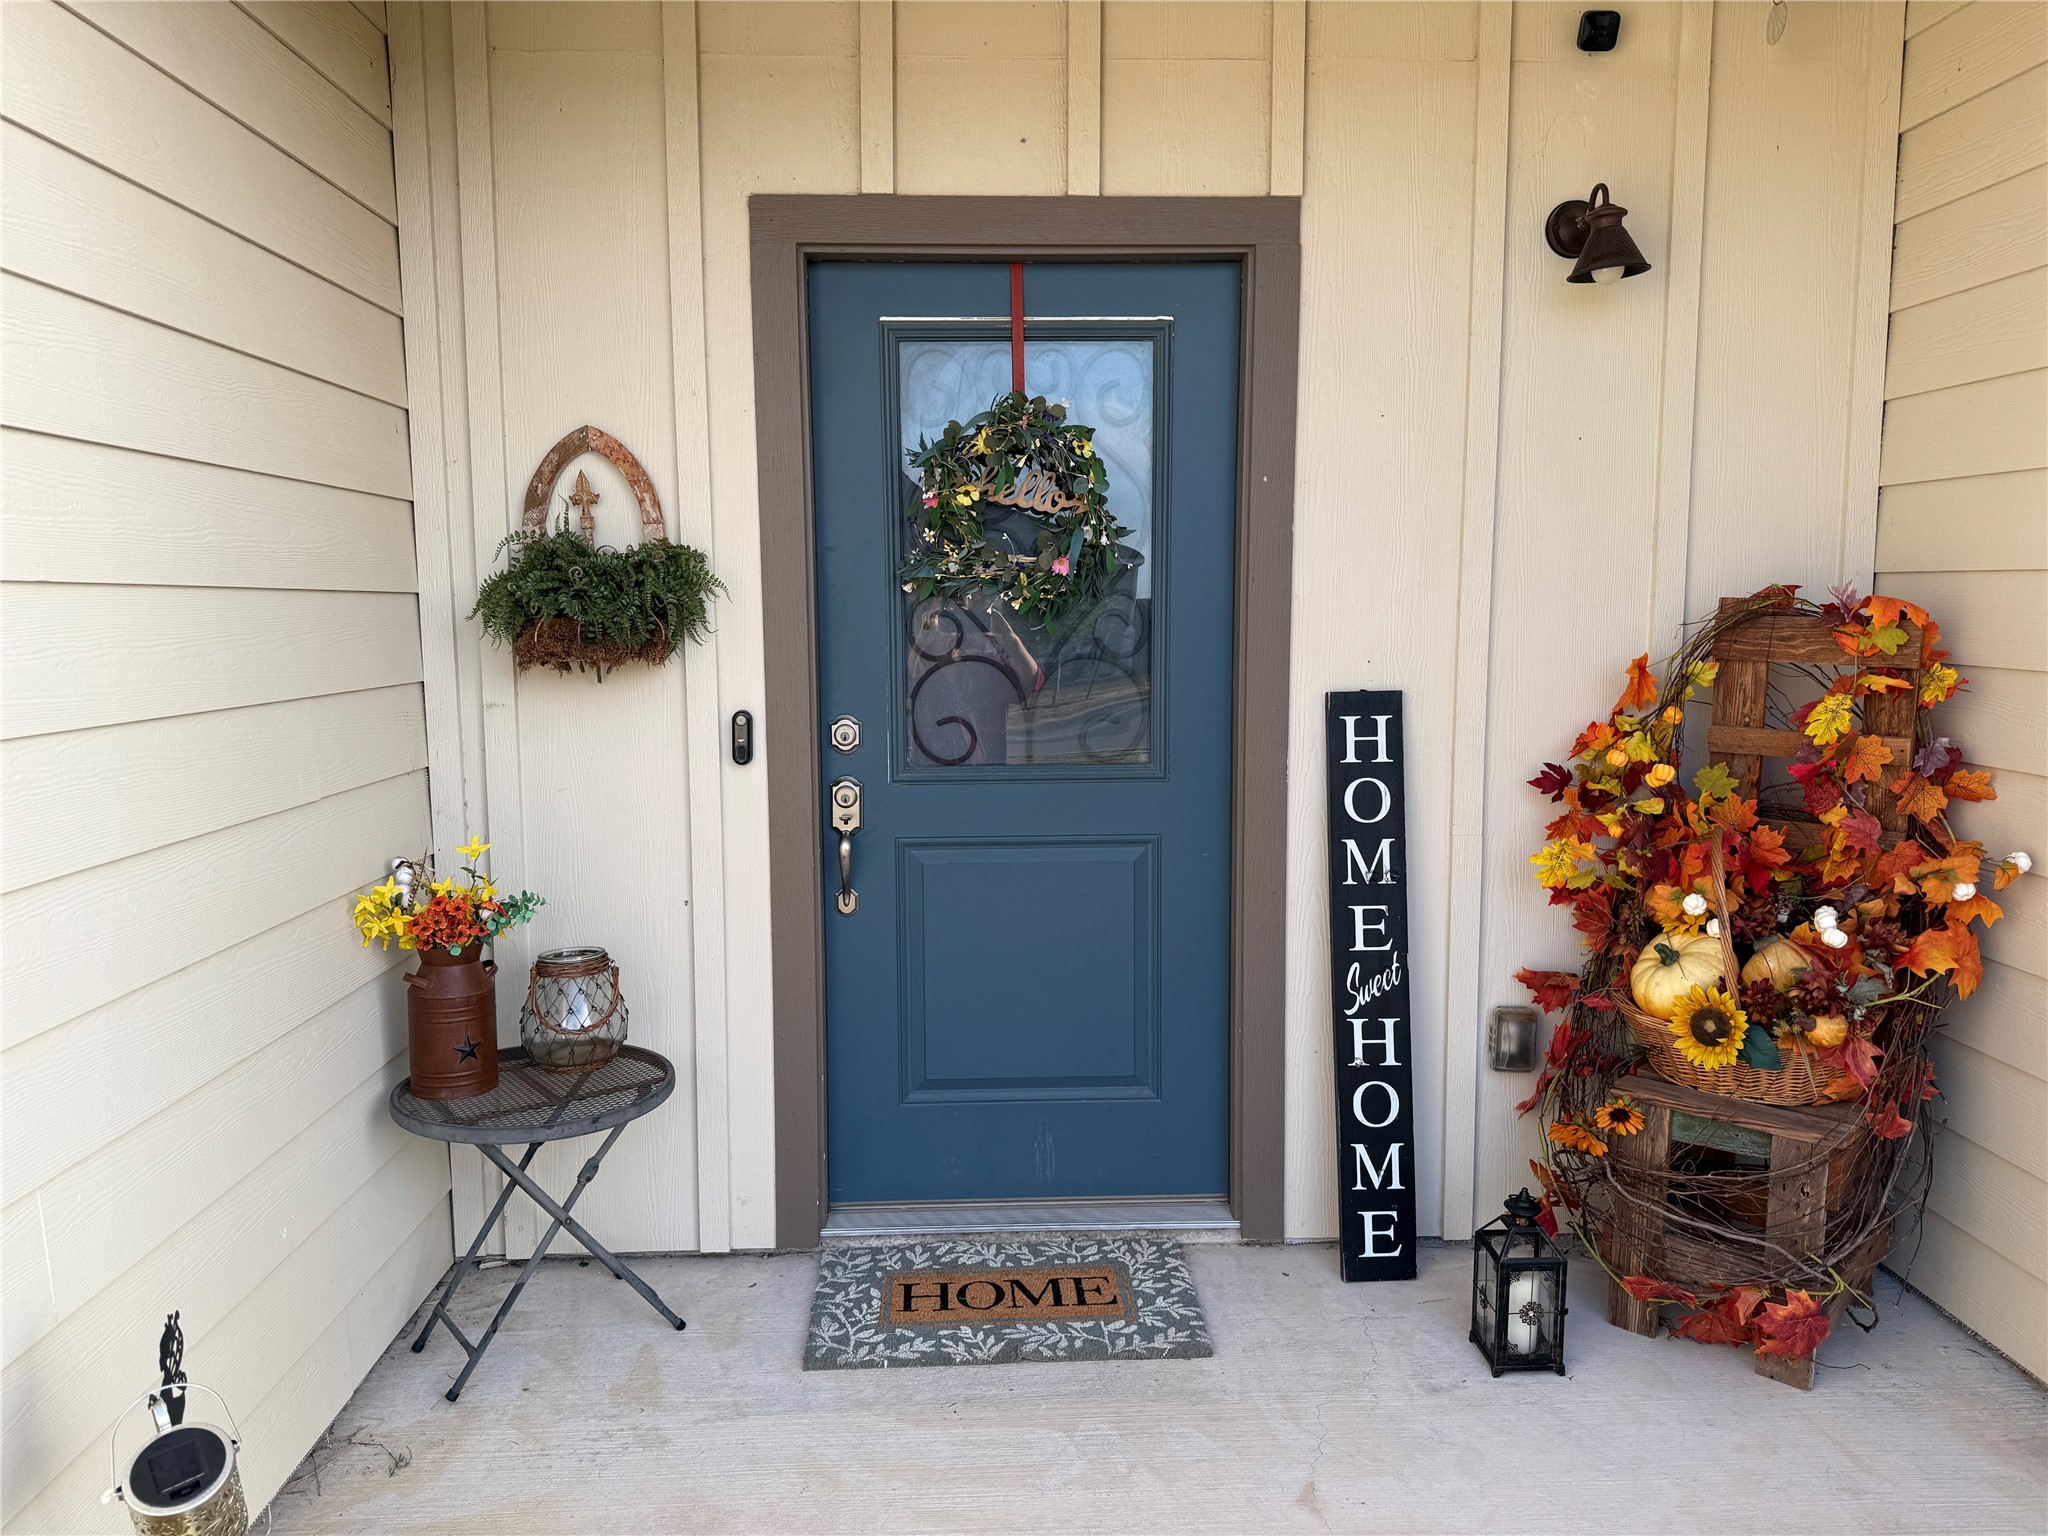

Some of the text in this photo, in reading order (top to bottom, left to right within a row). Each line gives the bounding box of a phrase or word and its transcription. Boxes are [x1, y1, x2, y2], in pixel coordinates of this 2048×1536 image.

[1339, 715, 1396, 951] HOME
[1344, 951, 1401, 1015] Sweet
[1346, 1018, 1405, 1258] HOME
[896, 1275, 1119, 1313] HOME
